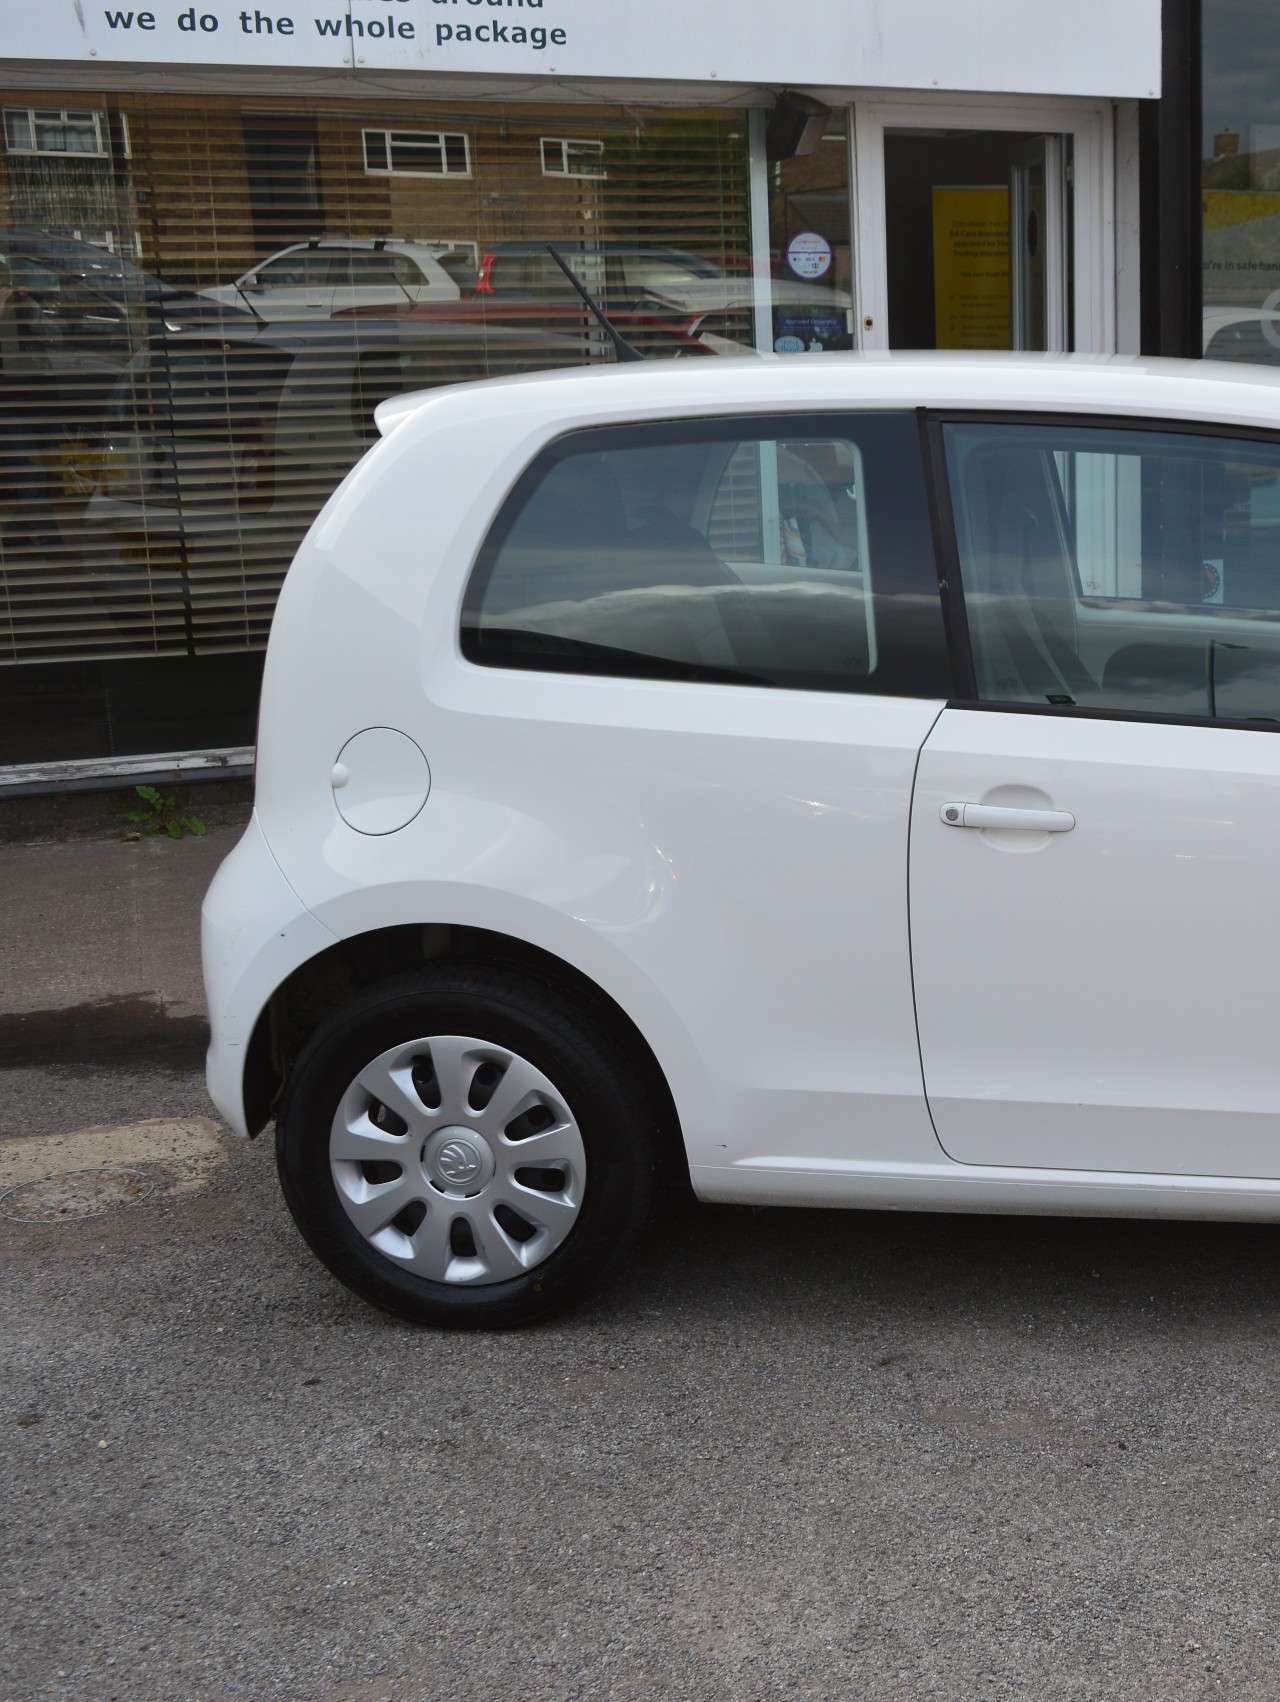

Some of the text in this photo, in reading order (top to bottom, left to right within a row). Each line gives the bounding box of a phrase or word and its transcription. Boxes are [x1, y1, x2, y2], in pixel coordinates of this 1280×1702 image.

[104, 8, 566, 49] we do the whole package
